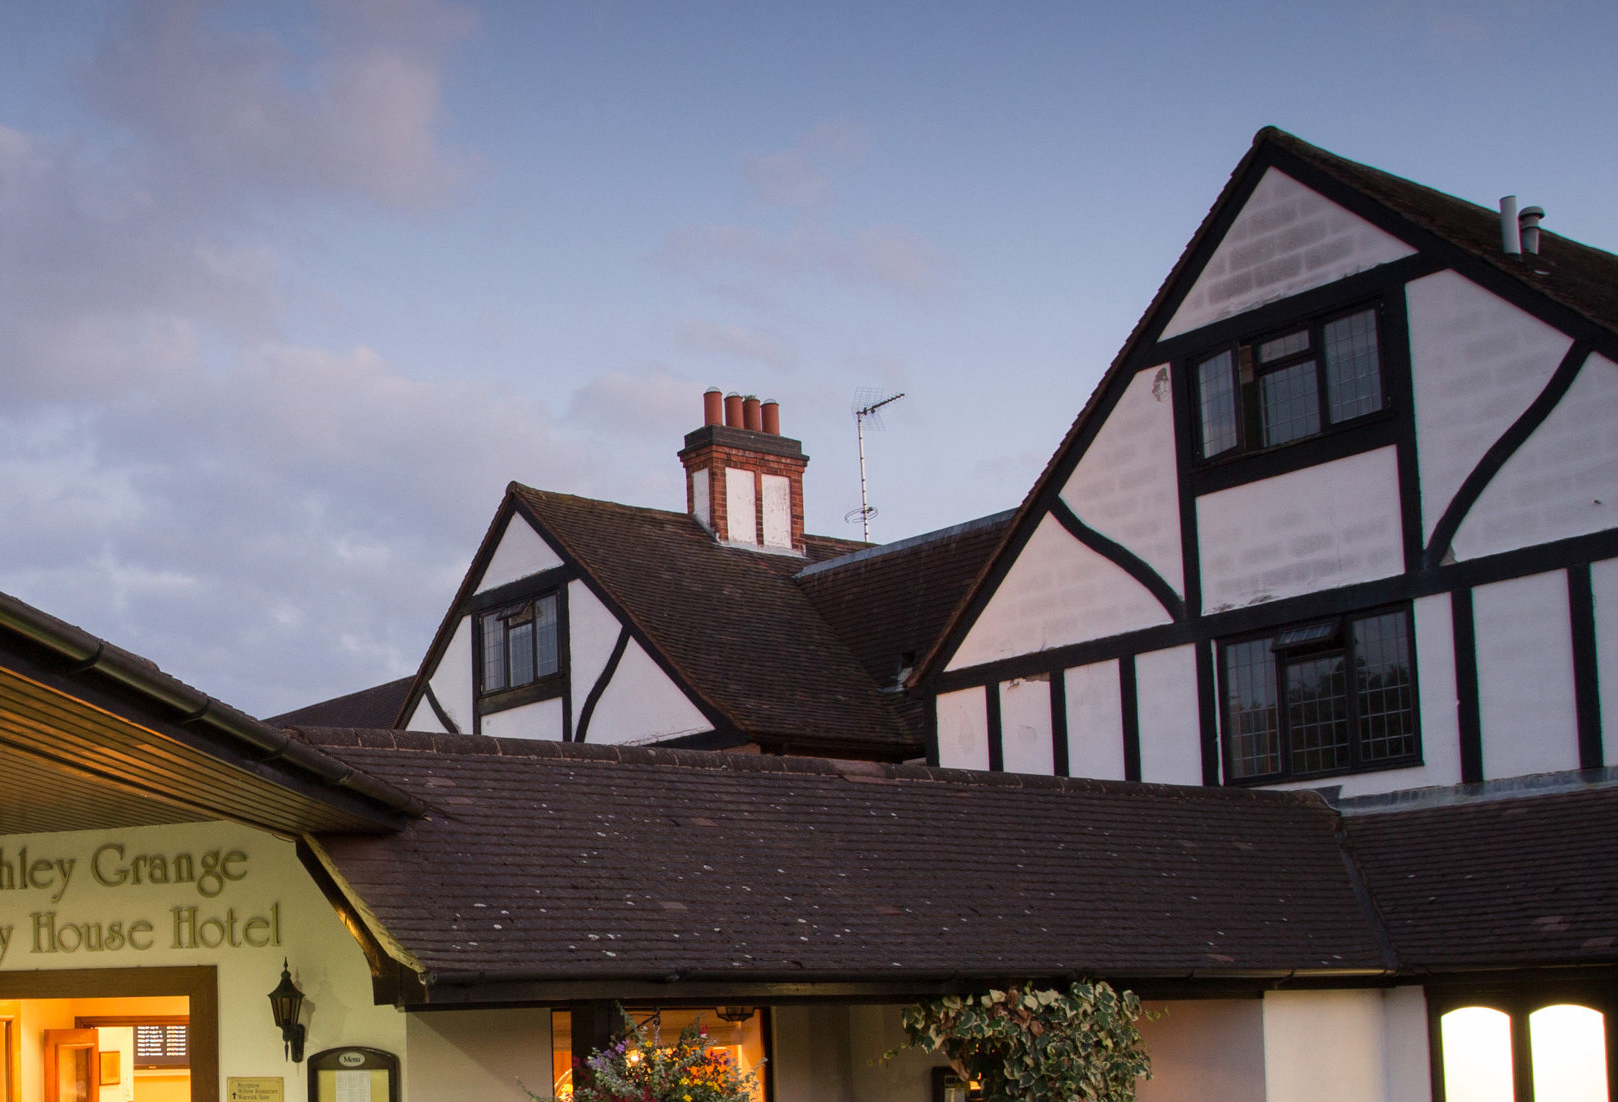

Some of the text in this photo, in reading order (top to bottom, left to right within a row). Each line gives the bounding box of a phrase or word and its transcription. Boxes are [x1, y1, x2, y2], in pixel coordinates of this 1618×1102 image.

[91, 843, 248, 898] Grange
[30, 911, 154, 953] House
[169, 901, 282, 950] Hotel
[343, 1055, 361, 1063] Menu
